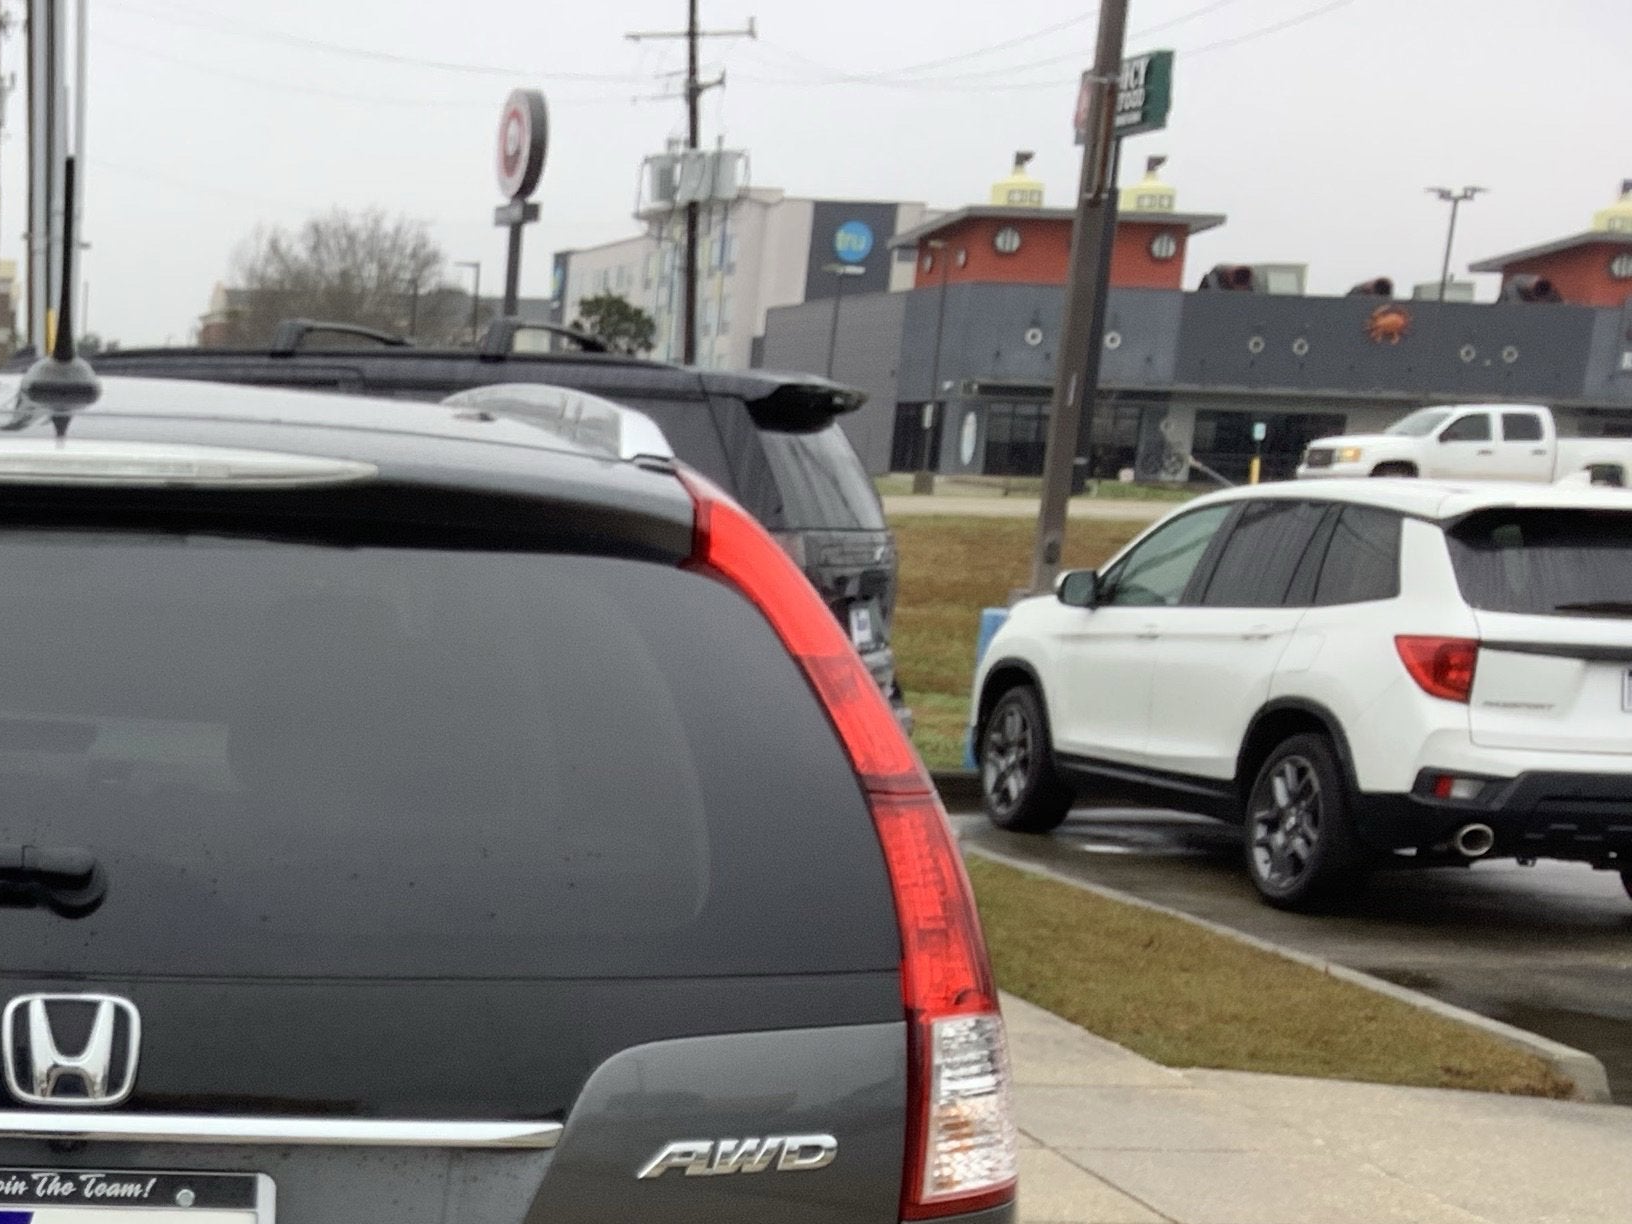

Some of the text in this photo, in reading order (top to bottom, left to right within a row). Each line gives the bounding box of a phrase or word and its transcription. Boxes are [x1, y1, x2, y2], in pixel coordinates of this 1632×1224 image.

[636, 1133, 839, 1180] AWD
[31, 1172, 77, 1197] The
[79, 1173, 157, 1199] Team!
